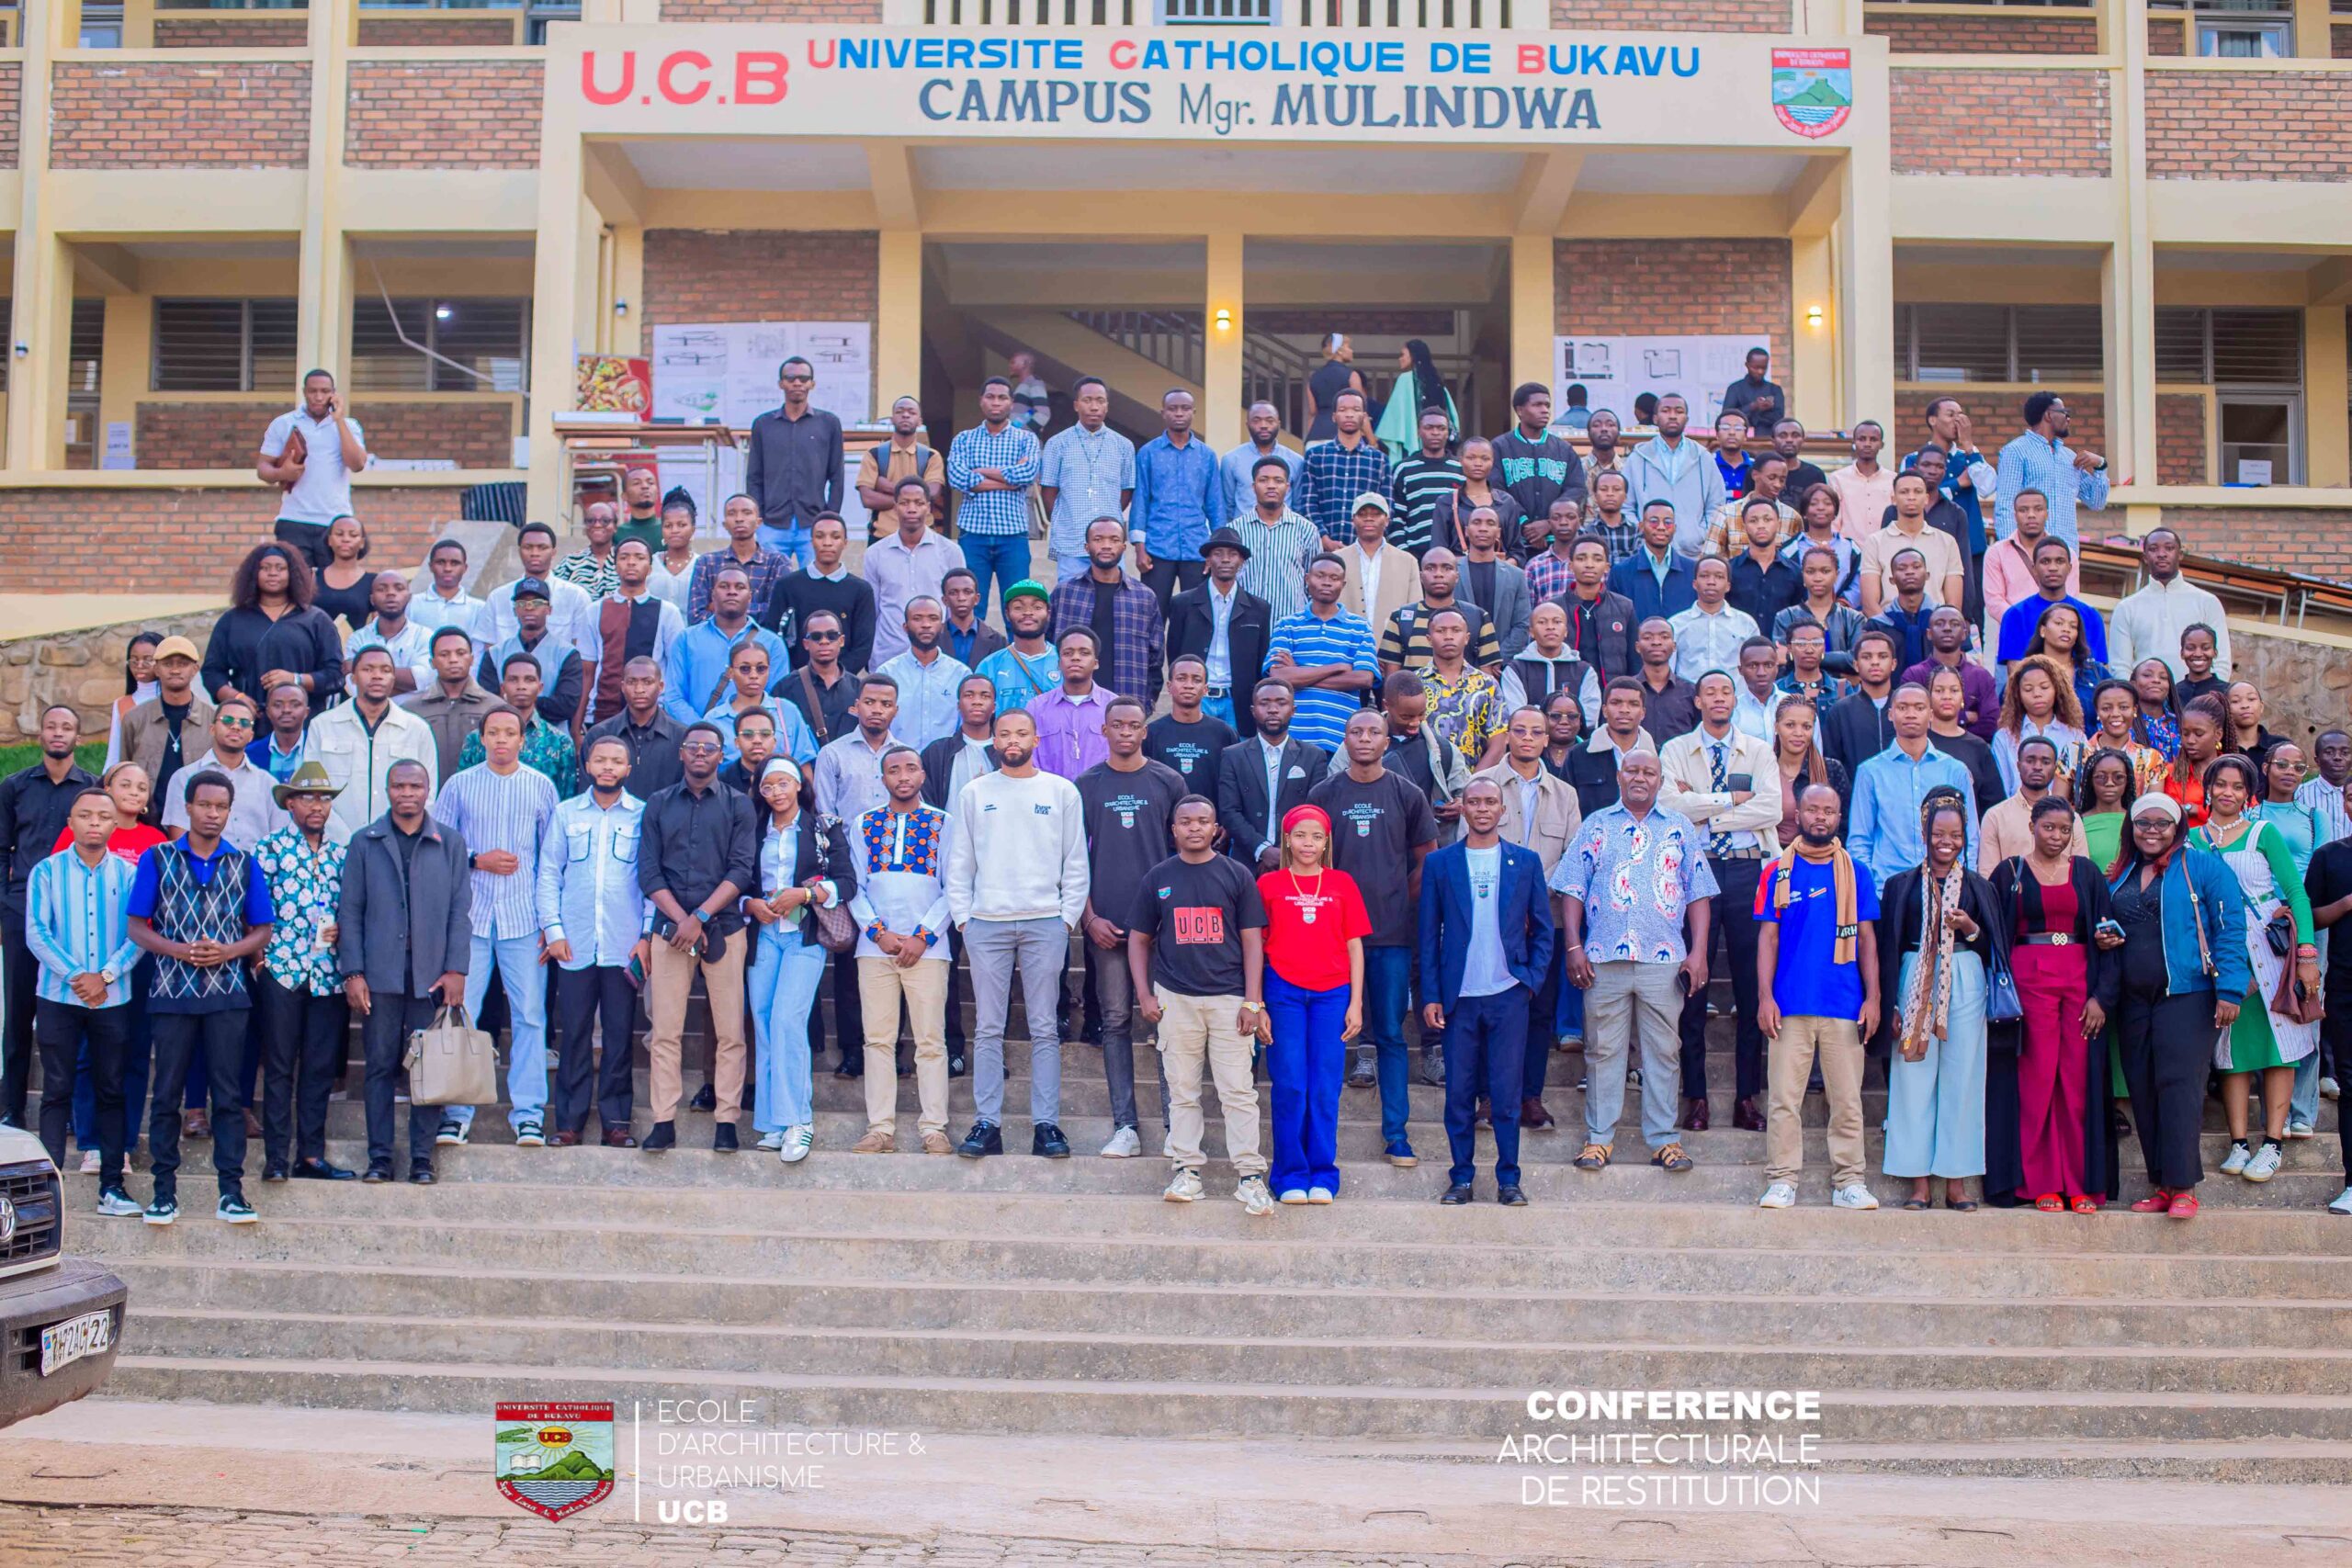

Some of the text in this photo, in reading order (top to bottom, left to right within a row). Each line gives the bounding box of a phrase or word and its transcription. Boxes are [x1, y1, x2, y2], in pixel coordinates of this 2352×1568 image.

[582, 50, 789, 106] U.C.B
[808, 38, 1701, 78] UNIVERSITE CATHOLIQUE DE BUKAVU
[919, 78, 1602, 135] CAMPUS Mgr. MULINDWA
